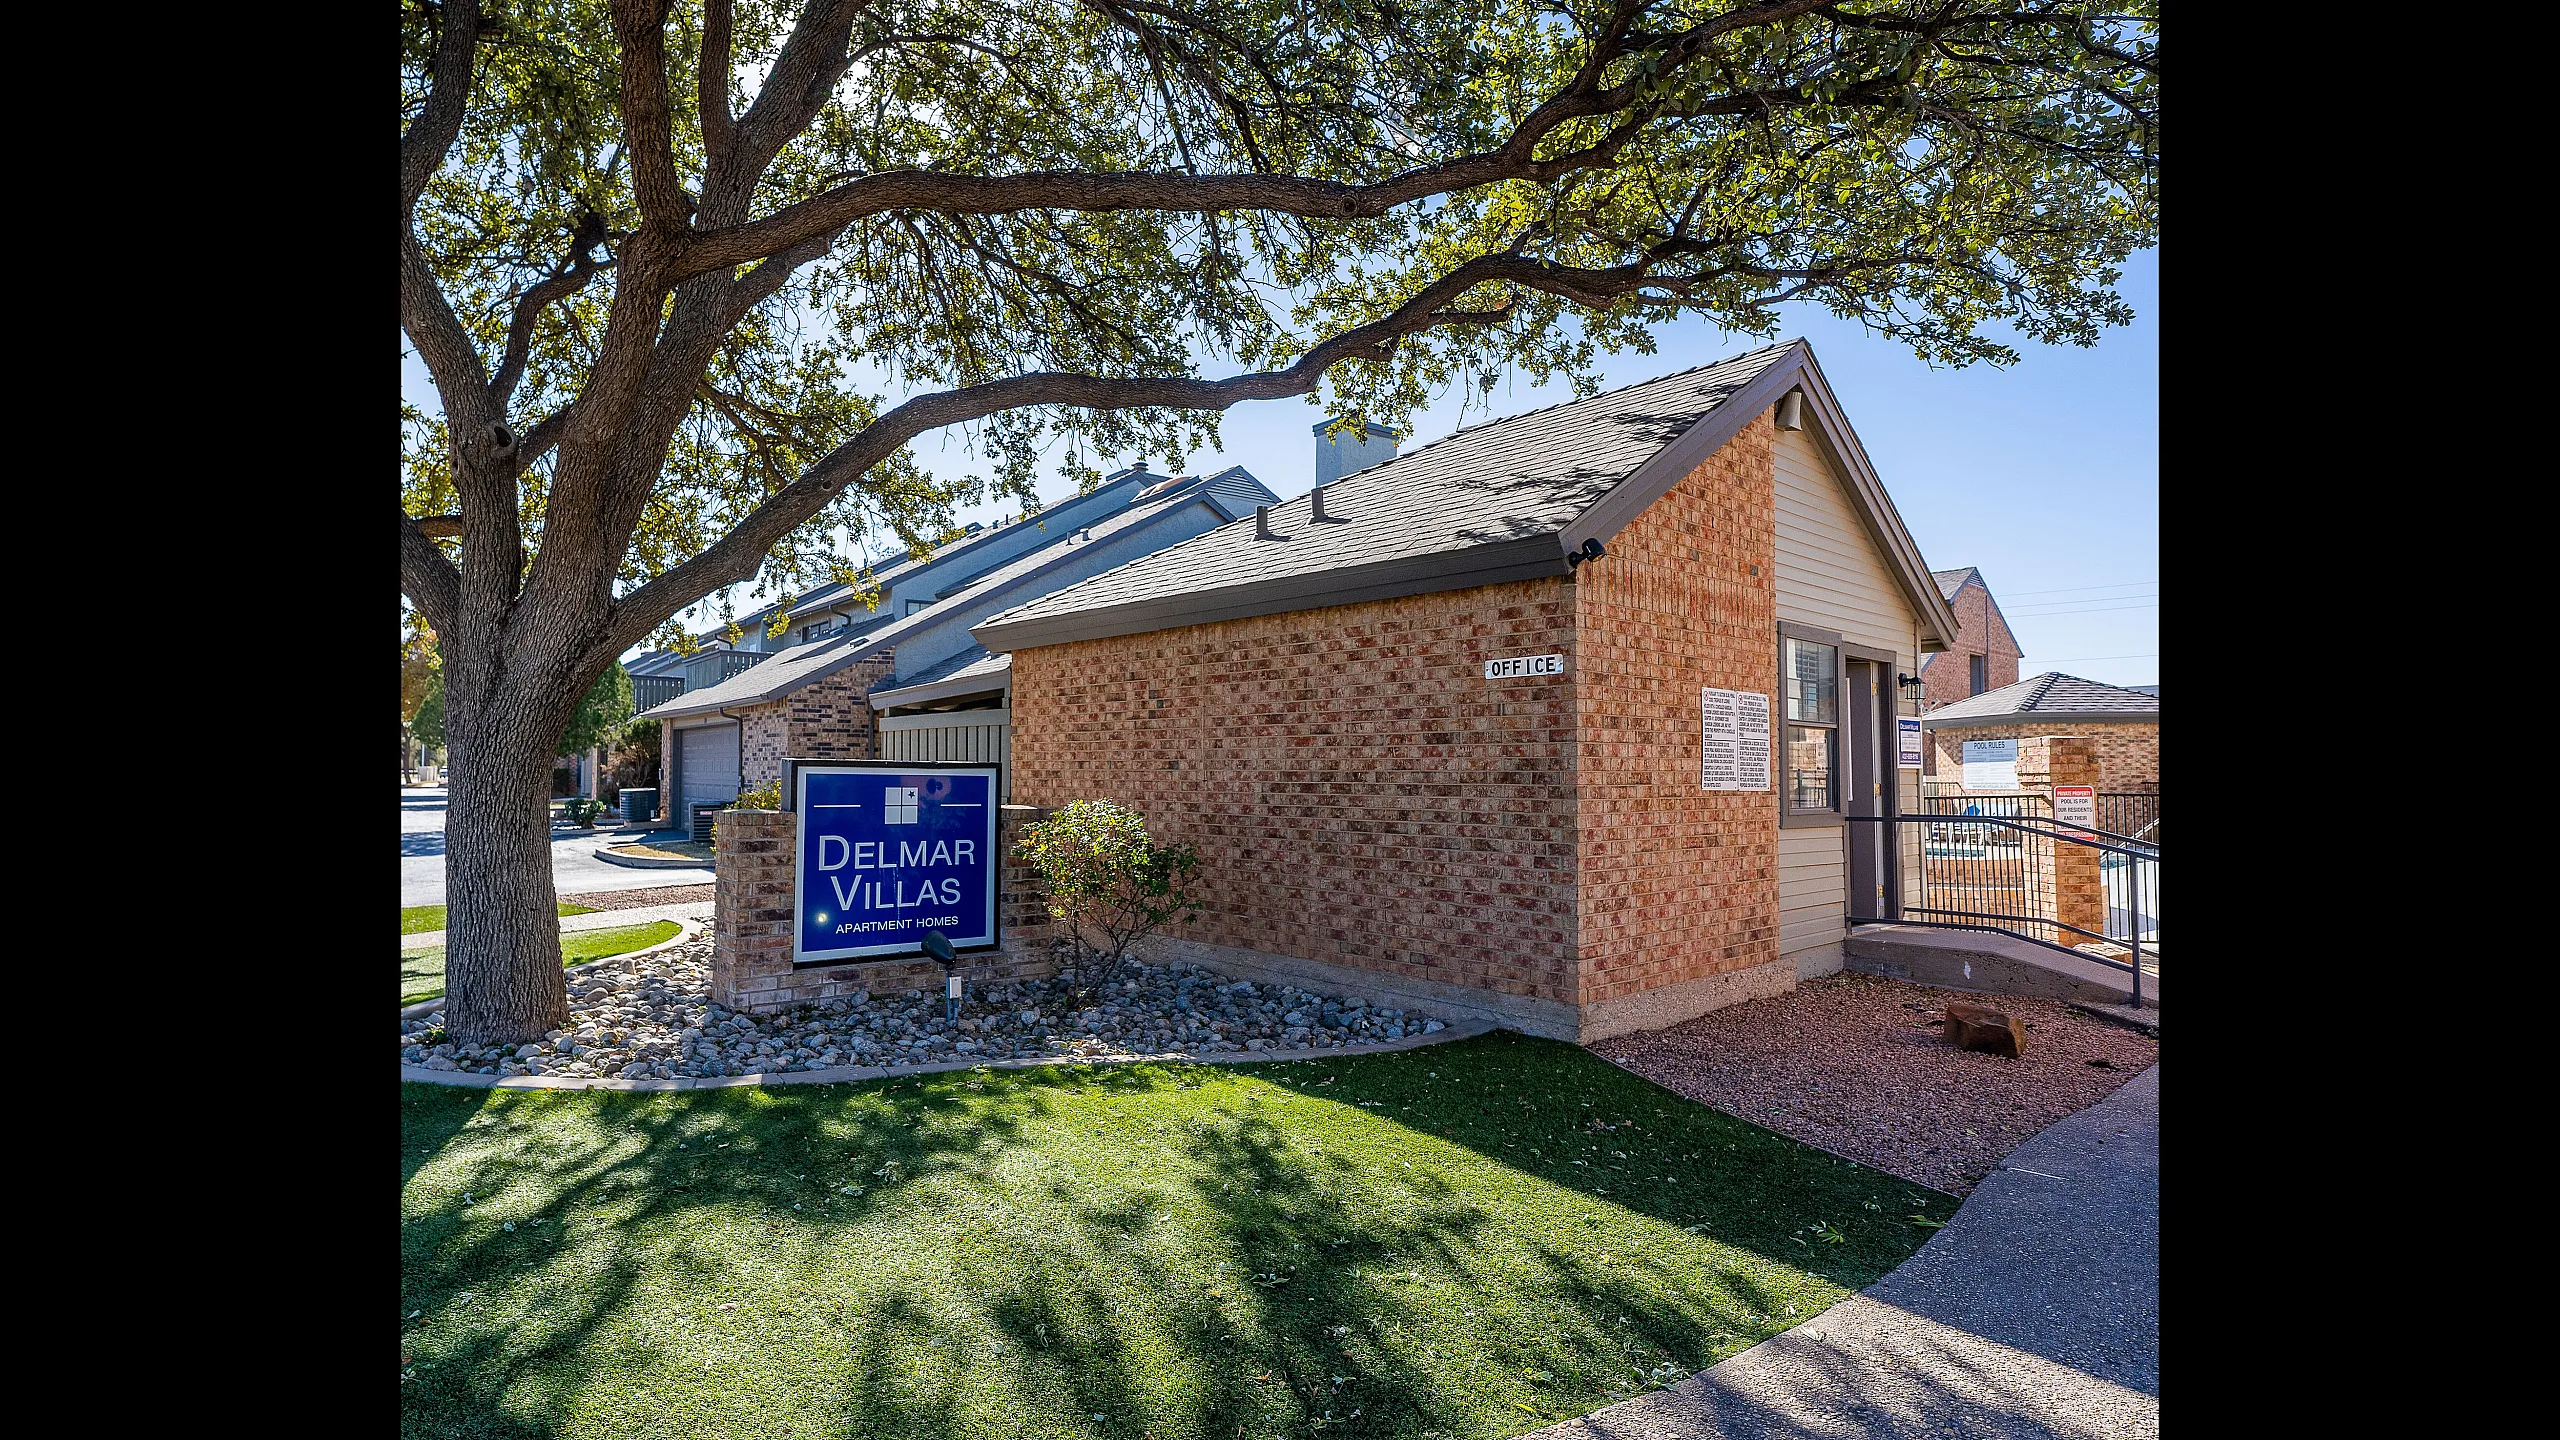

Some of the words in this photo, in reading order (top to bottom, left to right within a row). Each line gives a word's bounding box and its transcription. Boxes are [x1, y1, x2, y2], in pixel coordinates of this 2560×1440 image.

[1491, 656, 1556, 676] OFFICE
[1973, 742, 1987, 750] POOL
[1988, 741, 2006, 749] RULES
[818, 835, 975, 871] DELMAR
[830, 874, 961, 911] VILLAS
[835, 919, 913, 935] APARTMENT
[916, 915, 959, 929] HOMES
